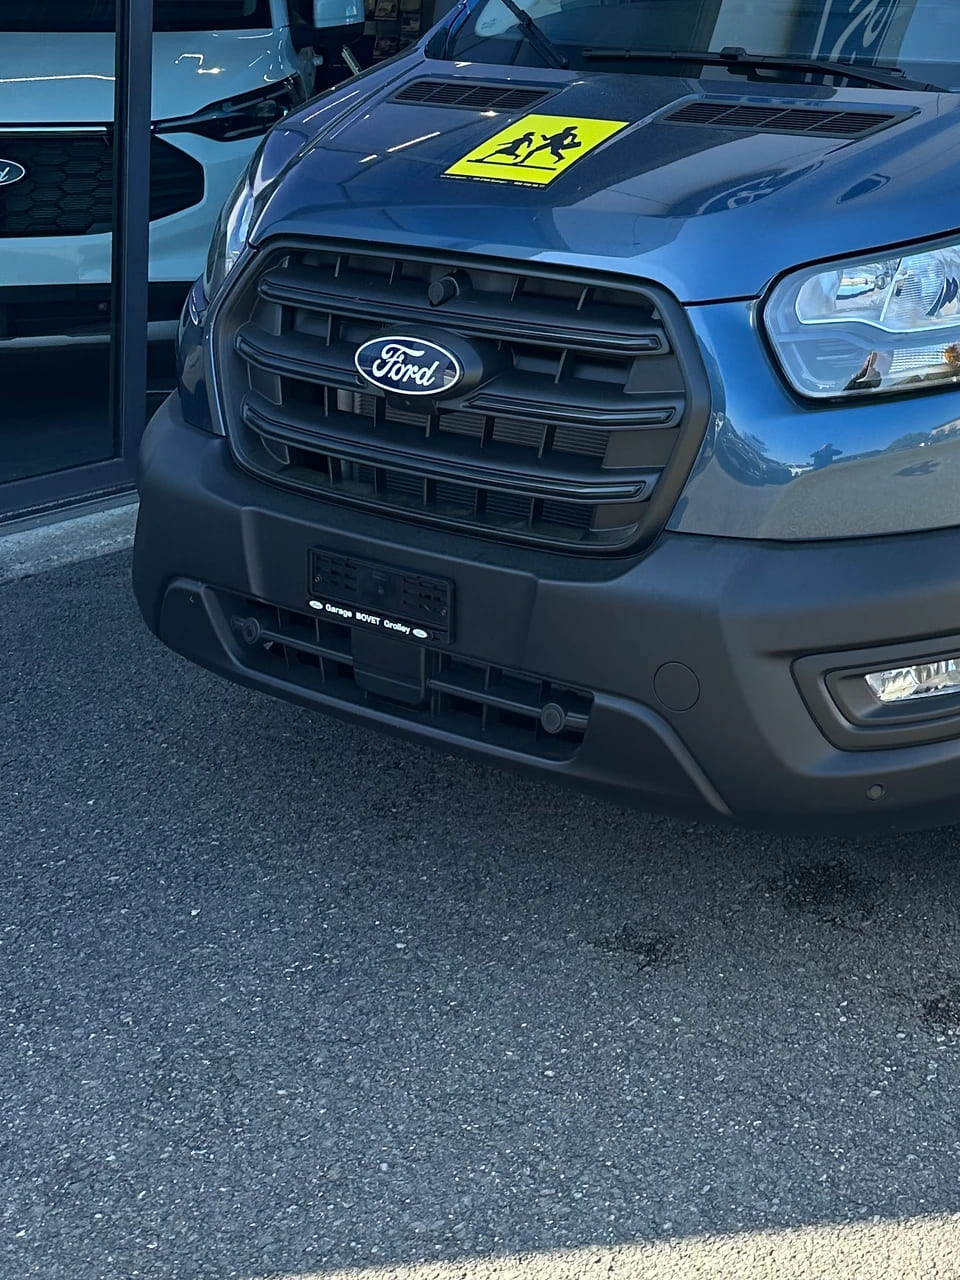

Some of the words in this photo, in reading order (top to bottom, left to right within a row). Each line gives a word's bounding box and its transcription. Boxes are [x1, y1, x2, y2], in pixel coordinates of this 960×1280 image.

[372, 343, 440, 387] Ford
[325, 603, 353, 618] Garage
[355, 612, 381, 626] BOVET
